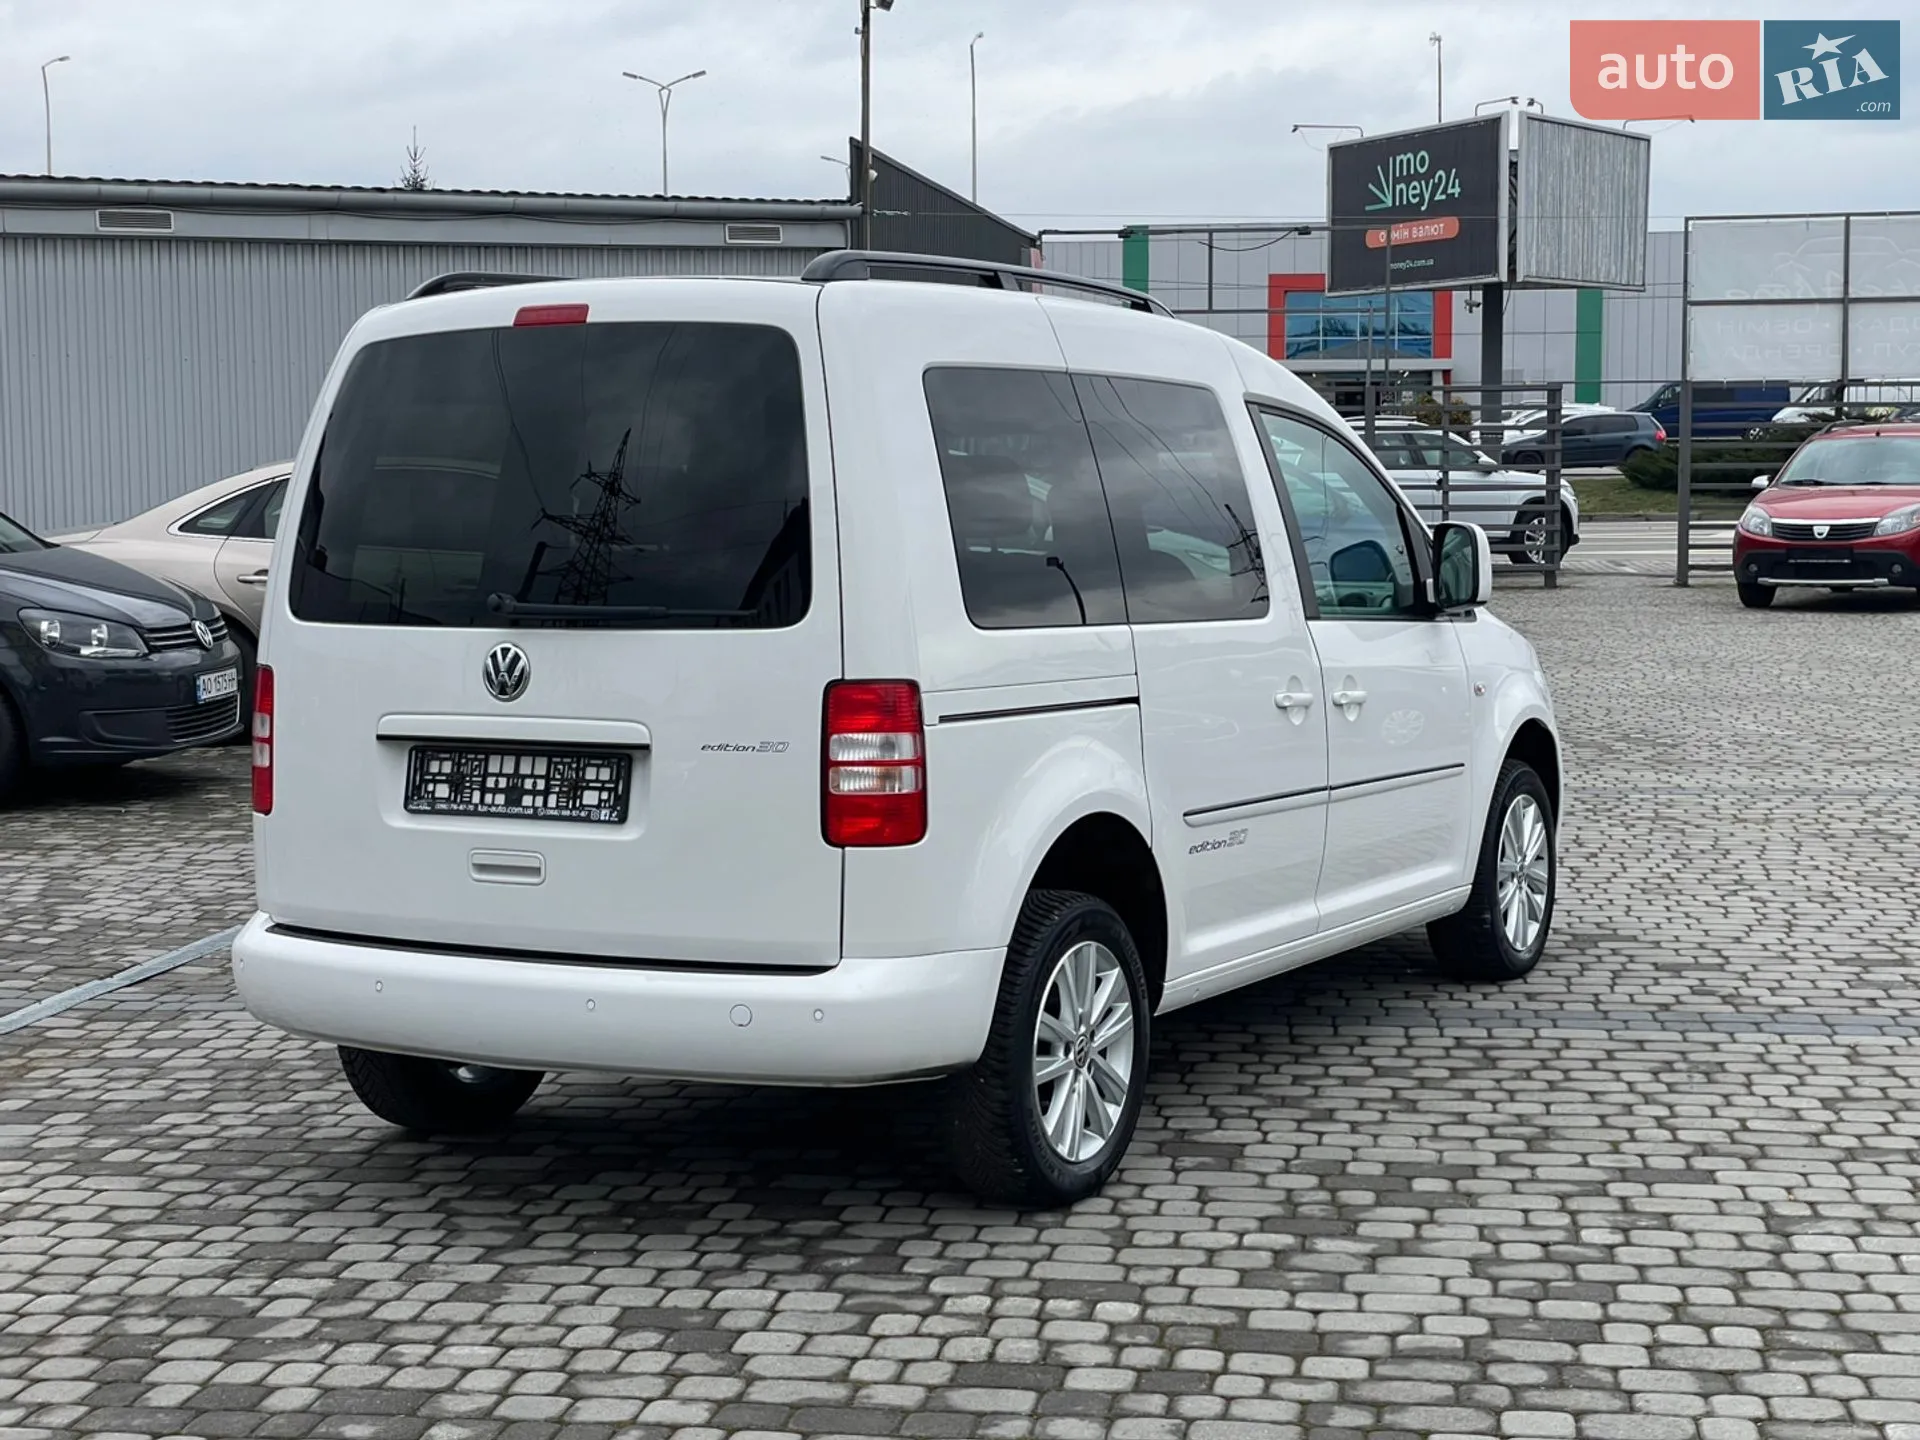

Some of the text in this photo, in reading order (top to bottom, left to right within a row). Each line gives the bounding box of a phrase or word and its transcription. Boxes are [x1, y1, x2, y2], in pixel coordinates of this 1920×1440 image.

[1395, 150, 1430, 177] mo
[1395, 168, 1461, 212] ney24
[1379, 224, 1409, 243] омін
[700, 740, 790, 753] edition 30
